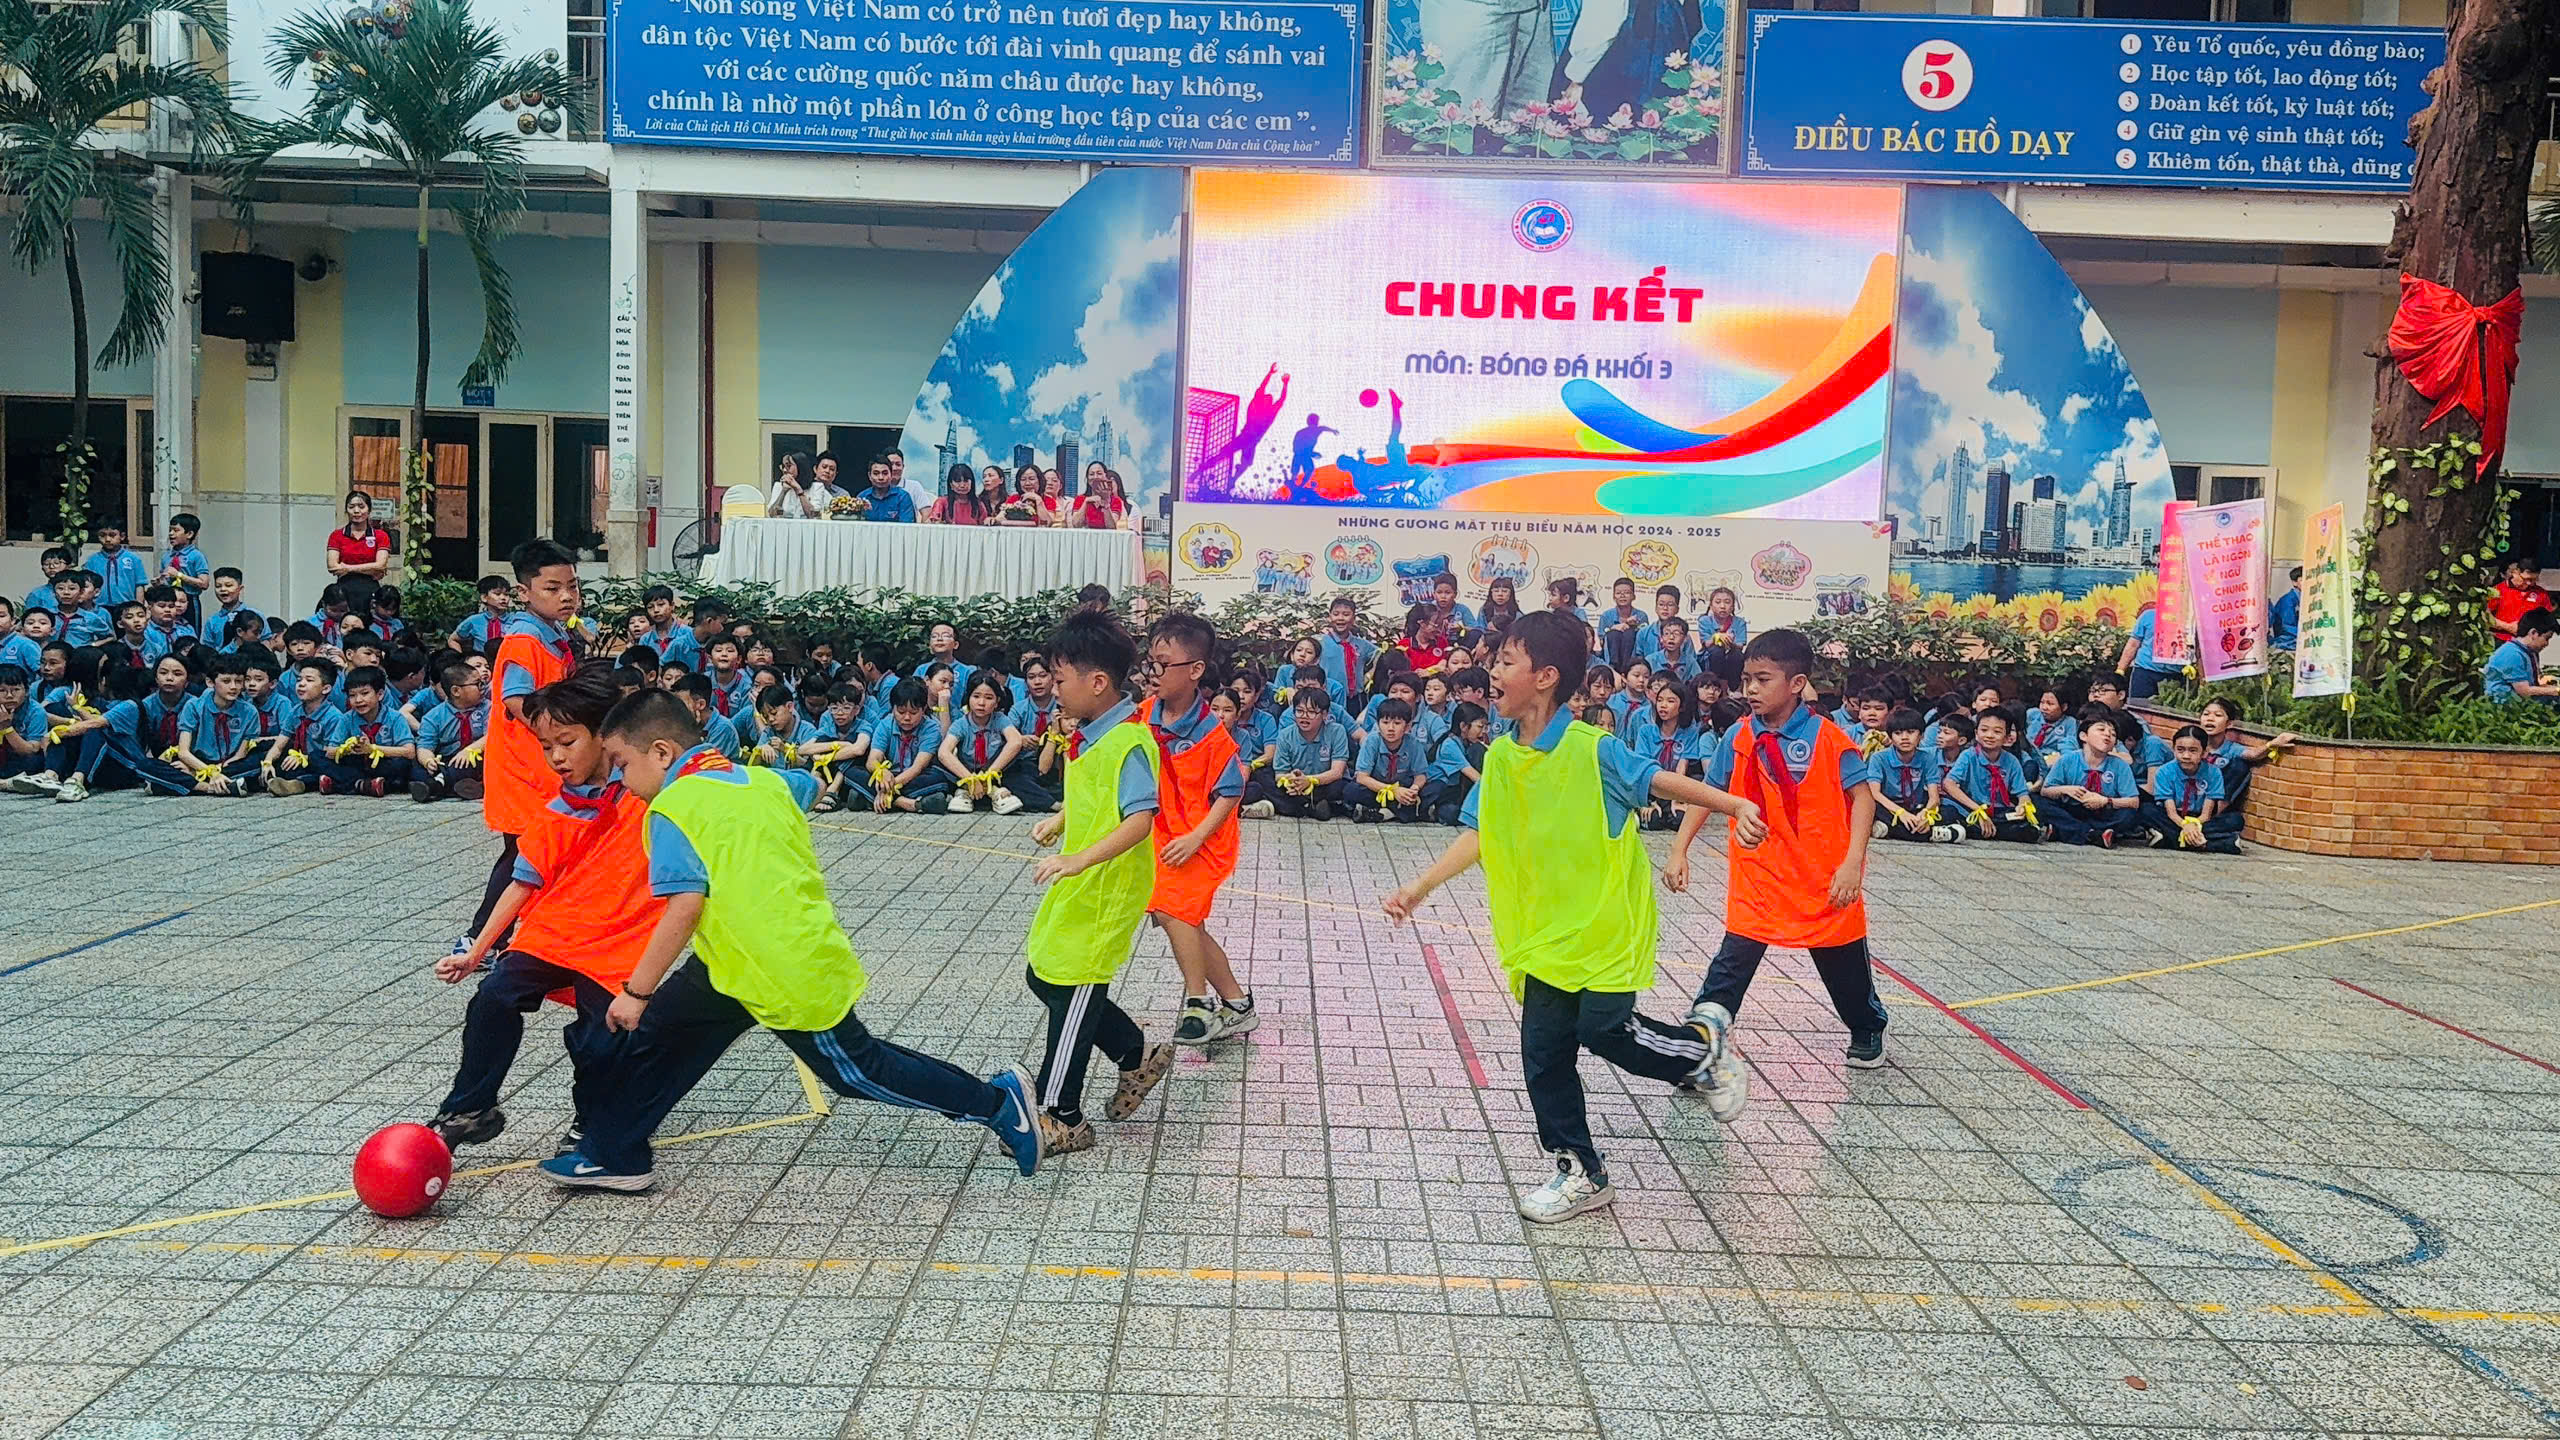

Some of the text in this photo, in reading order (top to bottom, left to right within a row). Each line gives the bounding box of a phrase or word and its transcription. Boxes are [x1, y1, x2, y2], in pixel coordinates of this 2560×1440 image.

[864, 0, 920, 19] Nam
[928, 0, 954, 21] có
[964, 0, 1001, 23] trở
[1009, 4, 1054, 24] nên
[1063, 7, 1108, 26] tươi
[1117, 8, 1161, 33] đẹp
[1169, 9, 1211, 35] hay
[1220, 11, 1301, 37] không,
[642, 25, 1324, 67] dân tộc Việt Nam có bước tới đài vinh quang để sánh vai
[2128, 34, 2424, 61] 1 Yêu Tổ quốc, yêu đồng bào;
[704, 59, 1263, 102] với các cường quốc năm châu được hay không,
[1920, 52, 1955, 99] 5
[2126, 64, 2397, 90] 2 Học tập tốt, lao động tốt;
[649, 90, 714, 111] chính
[723, 92, 742, 112] là
[753, 94, 798, 114] nhờ
[806, 96, 852, 120] một
[861, 94, 920, 122] phần
[929, 99, 966, 120] lớn
[974, 99, 989, 121] ở
[996, 103, 1053, 128] công
[1061, 105, 1102, 129] học
[1111, 107, 1151, 132] tập
[1158, 106, 1200, 128] của
[1208, 109, 1247, 130] các
[2125, 93, 2394, 119] 3 Đoàn kết tốt, kỷ luật tốt;
[645, 119, 663, 129] Lời
[665, 119, 684, 130] của
[687, 120, 708, 131] Chủ
[711, 122, 730, 133] tịch
[734, 122, 750, 132] Hồ
[752, 123, 772, 133] Chí
[774, 123, 801, 134] Minh
[804, 125, 828, 135] trích
[830, 128, 859, 139] trong
[909, 128, 929, 141] học
[932, 130, 953, 140] sinh
[956, 130, 983, 141] nhân
[985, 132, 1011, 145] ngày
[1013, 132, 1036, 143] khai
[1038, 133, 1072, 147] trường
[1073, 135, 1093, 145] đầu
[1096, 136, 1115, 146] tiên
[1117, 136, 1137, 146] của
[1139, 137, 1164, 147] nước
[1167, 138, 1188, 150] Việt
[1189, 138, 1214, 149] Nam
[1216, 139, 1239, 150] Dân
[1241, 139, 1260, 150] chủ
[1263, 140, 1291, 154] Cộng
[1793, 113, 2075, 161] ĐIỀU BÁC HỒ DẠY
[2123, 123, 2383, 148] 4 Giữ gìn vệ sinh thật tốt;
[2122, 153, 2130, 164] 5
[2148, 152, 2210, 169] Khiêm
[2218, 152, 2255, 174] tốn,
[2262, 155, 2302, 175] thật
[2308, 157, 2345, 176] thà,
[2352, 158, 2402, 179] dũng
[1384, 265, 1704, 323] CHUNG KẾT
[1480, 352, 1548, 377] BÓNG
[1554, 354, 1589, 378] ĐÁ
[1595, 352, 1653, 379] KHỐI
[1659, 360, 1673, 380] 3
[1338, 515, 1390, 529] NHỮNG
[1394, 518, 1450, 530] GƯƠNG
[1454, 519, 1487, 533] MẶT
[1491, 519, 1522, 532] TIÊU
[1526, 518, 1558, 533] BIỂU
[1563, 522, 1598, 534] NĂM
[1602, 524, 1634, 537] HỌC
[1638, 526, 1673, 536] 2024
[1687, 527, 1722, 538] 2025
[2222, 532, 2254, 547] THAO
[2204, 553, 2220, 567] LÀ
[2215, 582, 2249, 597] CHUNG
[2234, 598, 2256, 609] CON
